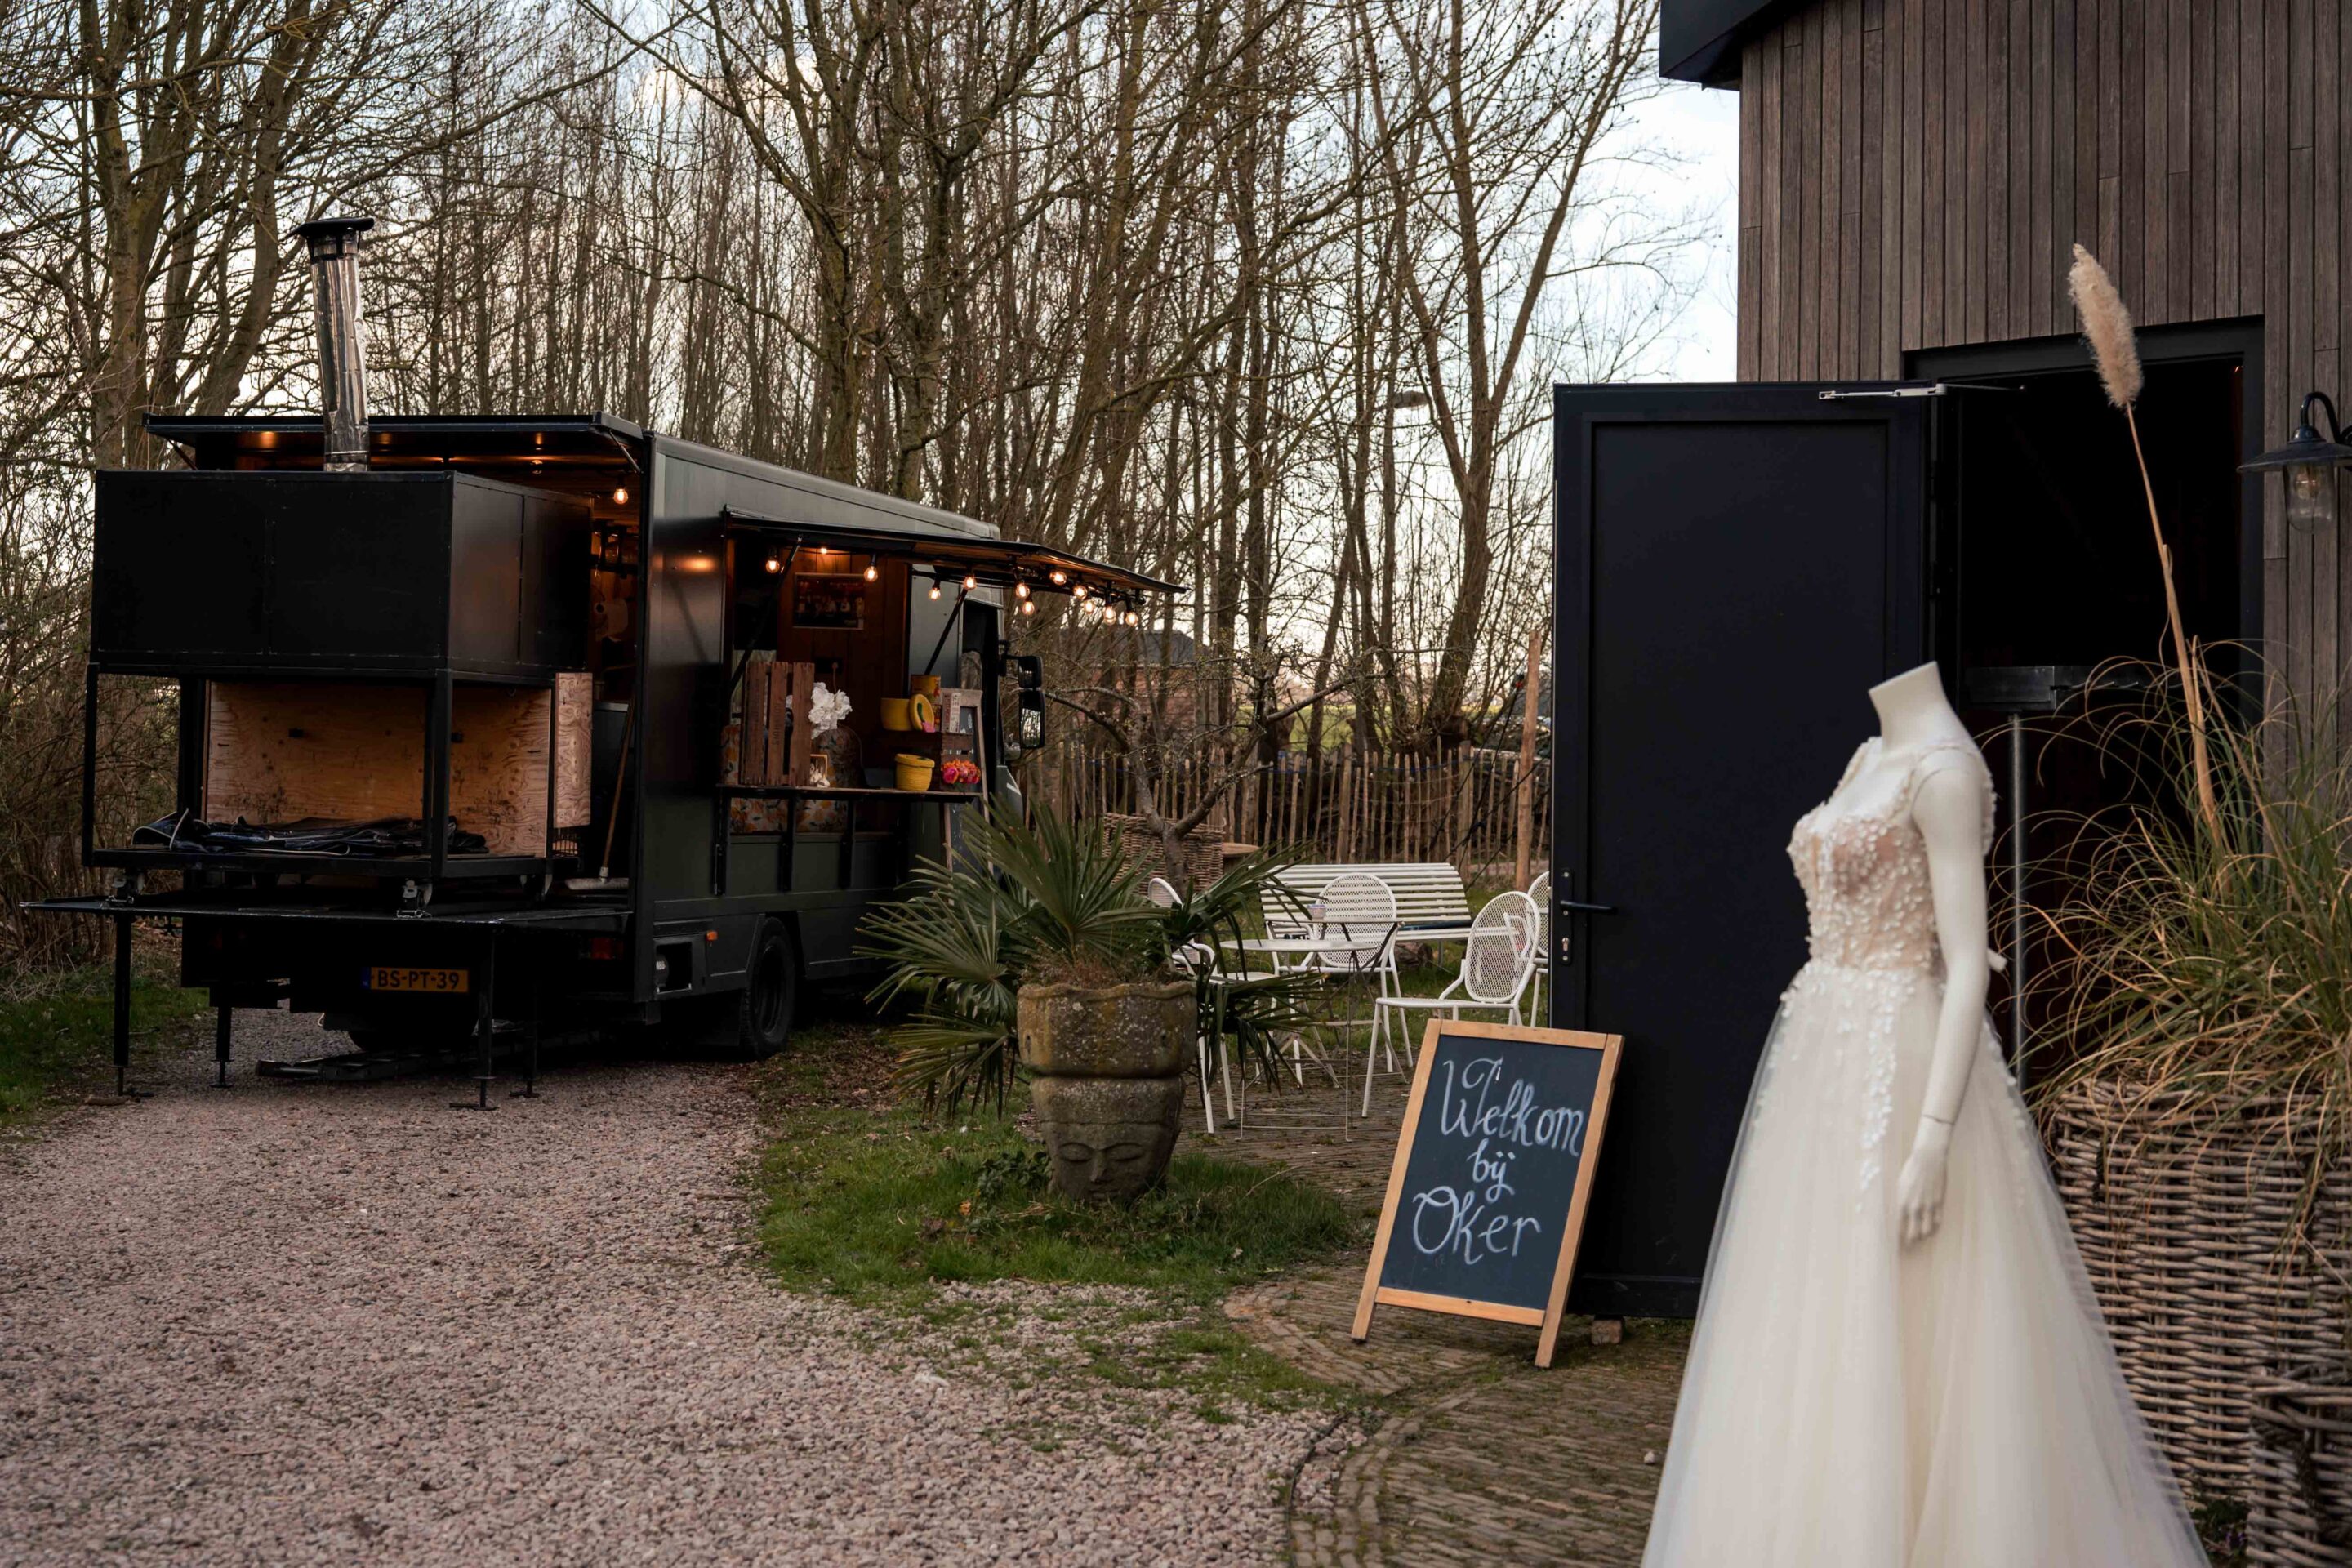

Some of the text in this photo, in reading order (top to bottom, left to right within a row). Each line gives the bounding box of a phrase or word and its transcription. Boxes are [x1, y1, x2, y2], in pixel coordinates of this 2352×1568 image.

[378, 970, 459, 989] BS-PT-39
[1441, 1056, 1584, 1156] Welkom
[1466, 1138, 1515, 1204] bij
